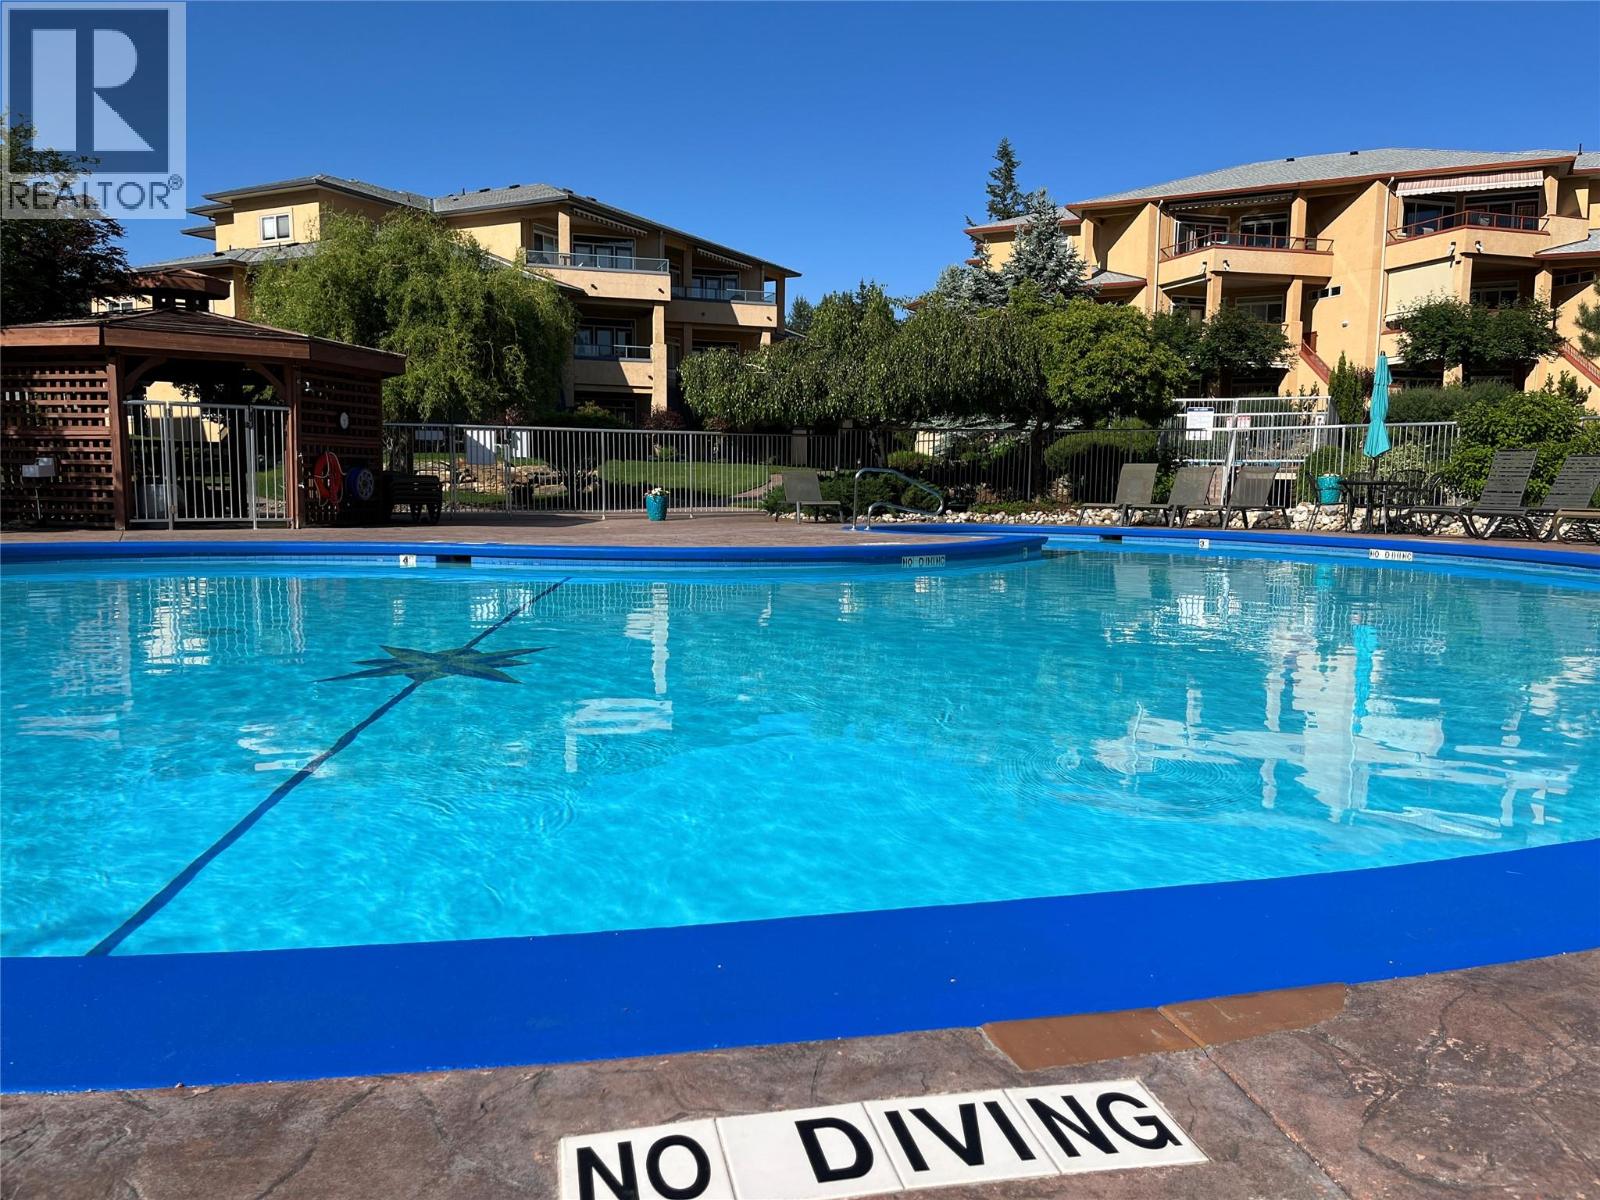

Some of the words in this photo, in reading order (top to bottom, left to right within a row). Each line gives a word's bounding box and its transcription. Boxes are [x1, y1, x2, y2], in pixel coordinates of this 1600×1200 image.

[902, 557, 913, 567] NO
[576, 1133, 712, 1200] NO
[794, 1091, 1183, 1183] DIVING
